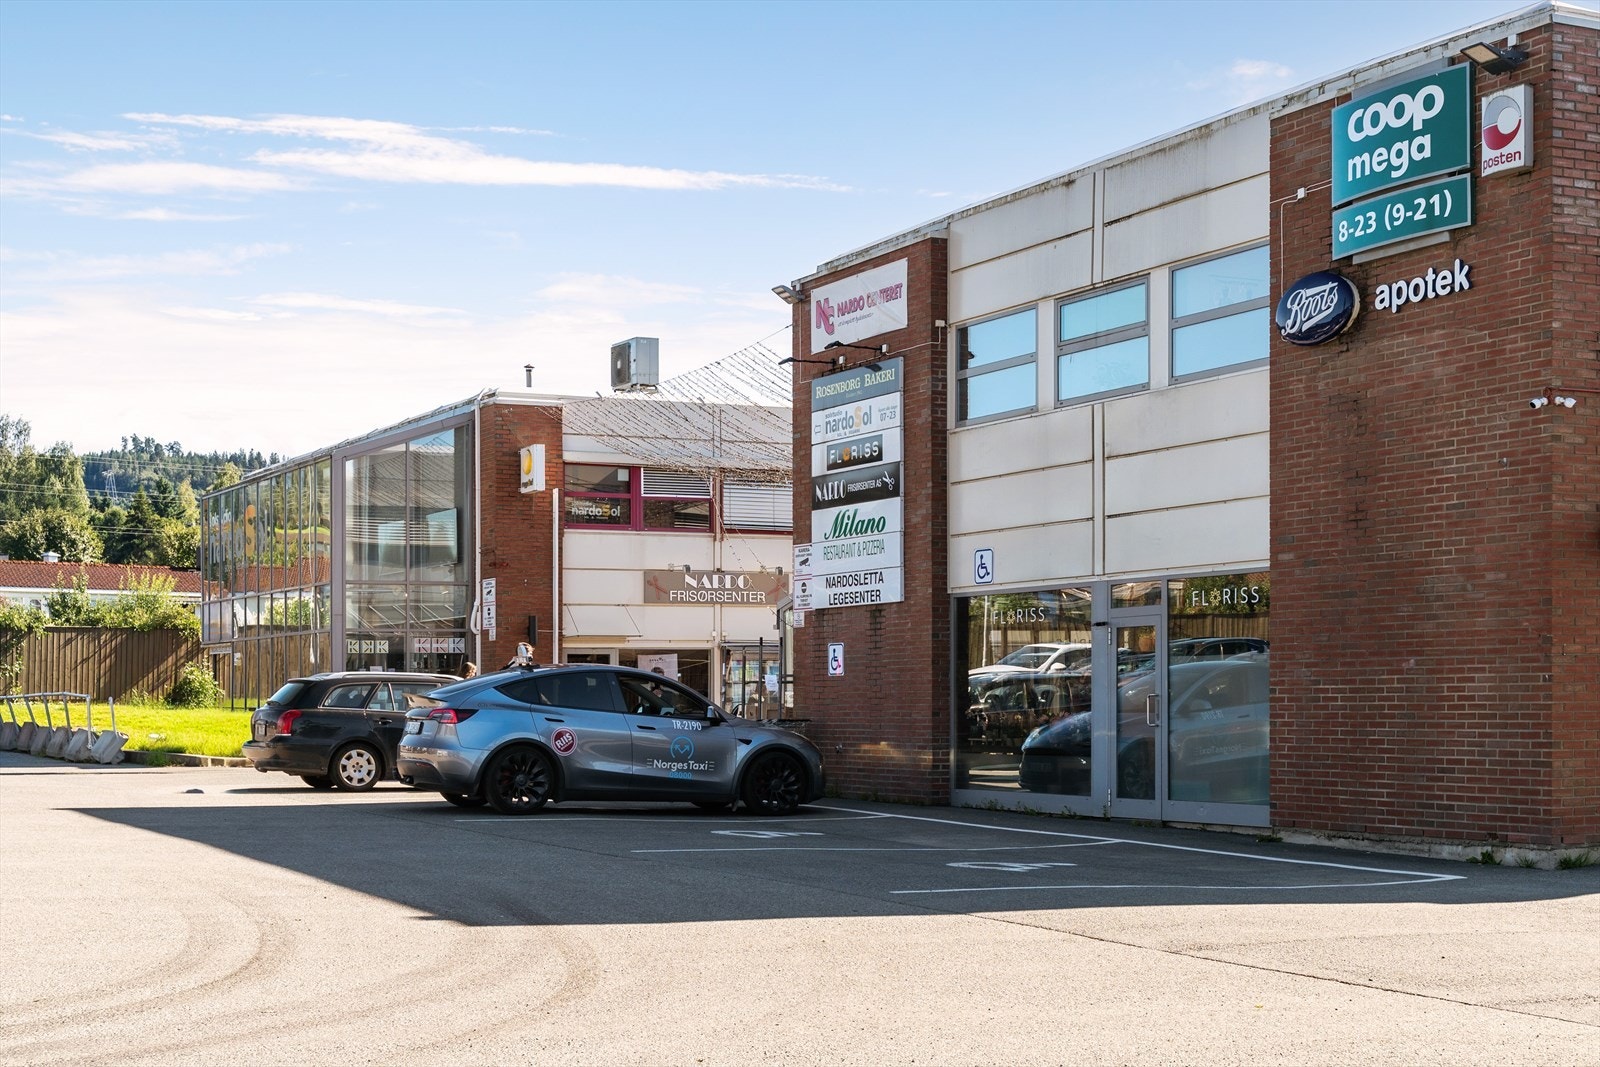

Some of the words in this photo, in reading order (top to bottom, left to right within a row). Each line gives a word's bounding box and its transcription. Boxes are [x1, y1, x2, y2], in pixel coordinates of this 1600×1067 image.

[1347, 84, 1445, 143] coop
[1347, 134, 1431, 182] mega
[1482, 149, 1521, 174] posten
[1338, 211, 1377, 242] 8-23
[1384, 190, 1452, 231] (9-21)
[1374, 259, 1471, 314] apotek
[837, 295, 865, 318] NARDO
[1281, 281, 1340, 336] Boots
[864, 368, 895, 387] BAKERI
[830, 441, 879, 464] FLORISS
[815, 479, 847, 502] NARDO
[824, 508, 886, 540] Milano
[823, 541, 857, 561] RESTAURANT
[857, 541, 862, 557] &
[863, 539, 886, 555] PIZZERIA
[684, 573, 753, 589] NARDO
[826, 571, 884, 590] NARDOSLETTA
[669, 590, 766, 603] FRISØRSENTER
[828, 589, 881, 606] LEGESENTER
[672, 720, 702, 731] TR-2190
[555, 732, 573, 749] RIIS
[653, 759, 709, 772] NorgesTaxi
